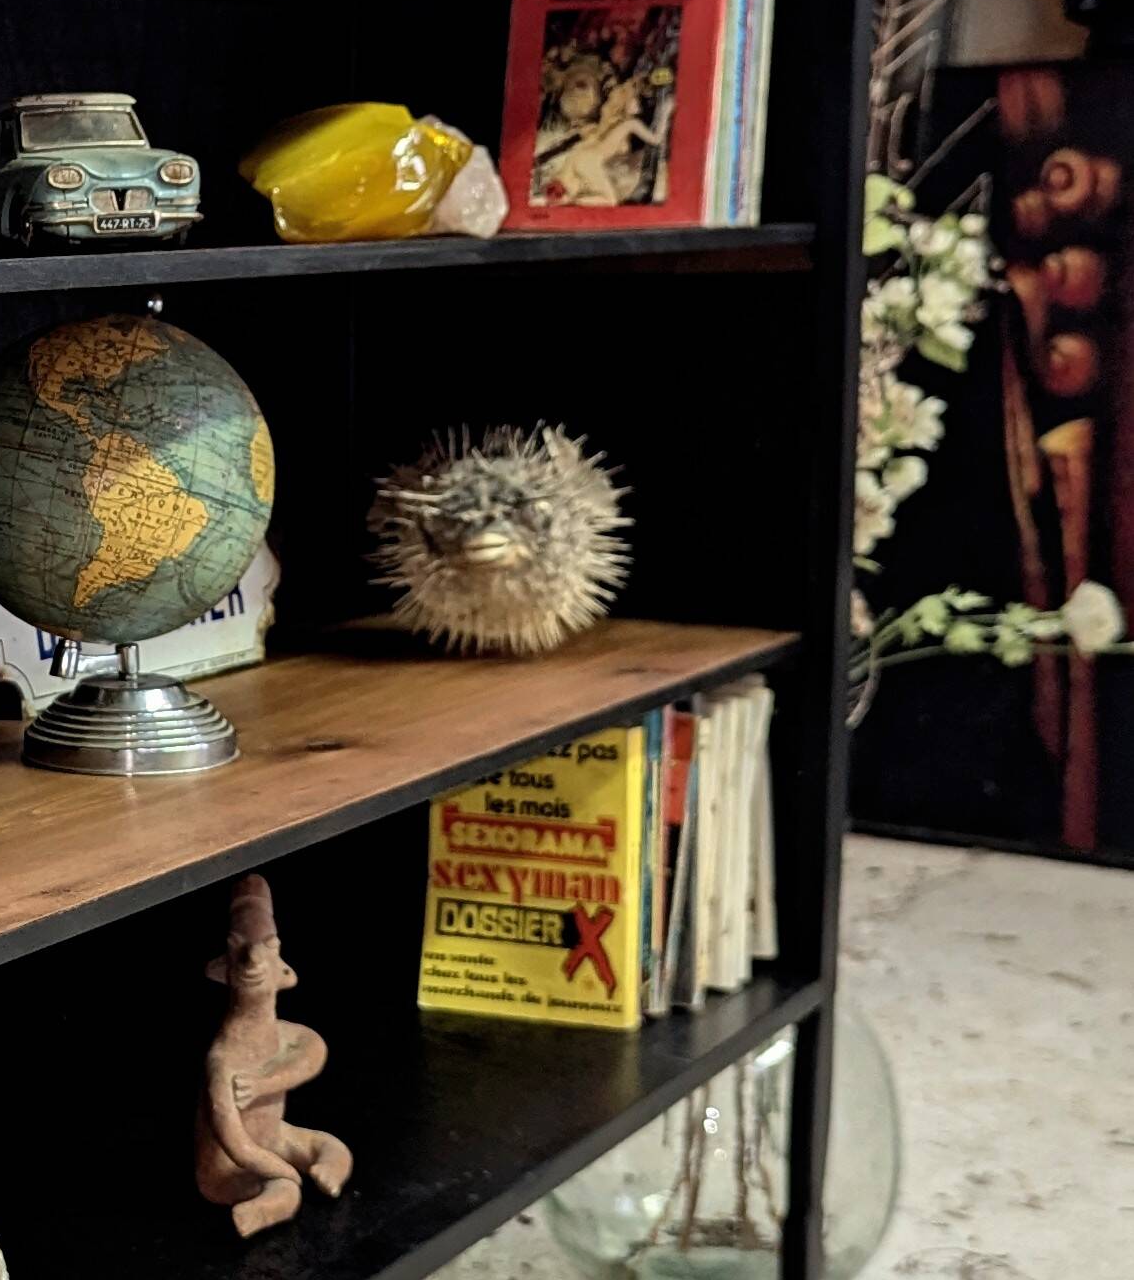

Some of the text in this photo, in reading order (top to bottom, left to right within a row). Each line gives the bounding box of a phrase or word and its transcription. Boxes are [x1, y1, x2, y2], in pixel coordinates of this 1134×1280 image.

[577, 743, 618, 764] pas
[509, 769, 555, 789] tous
[484, 791, 571, 819] les mois
[448, 819, 608, 859] SEXORAMA
[433, 859, 621, 905] sexyman
[440, 901, 616, 999] DOSSIER X
